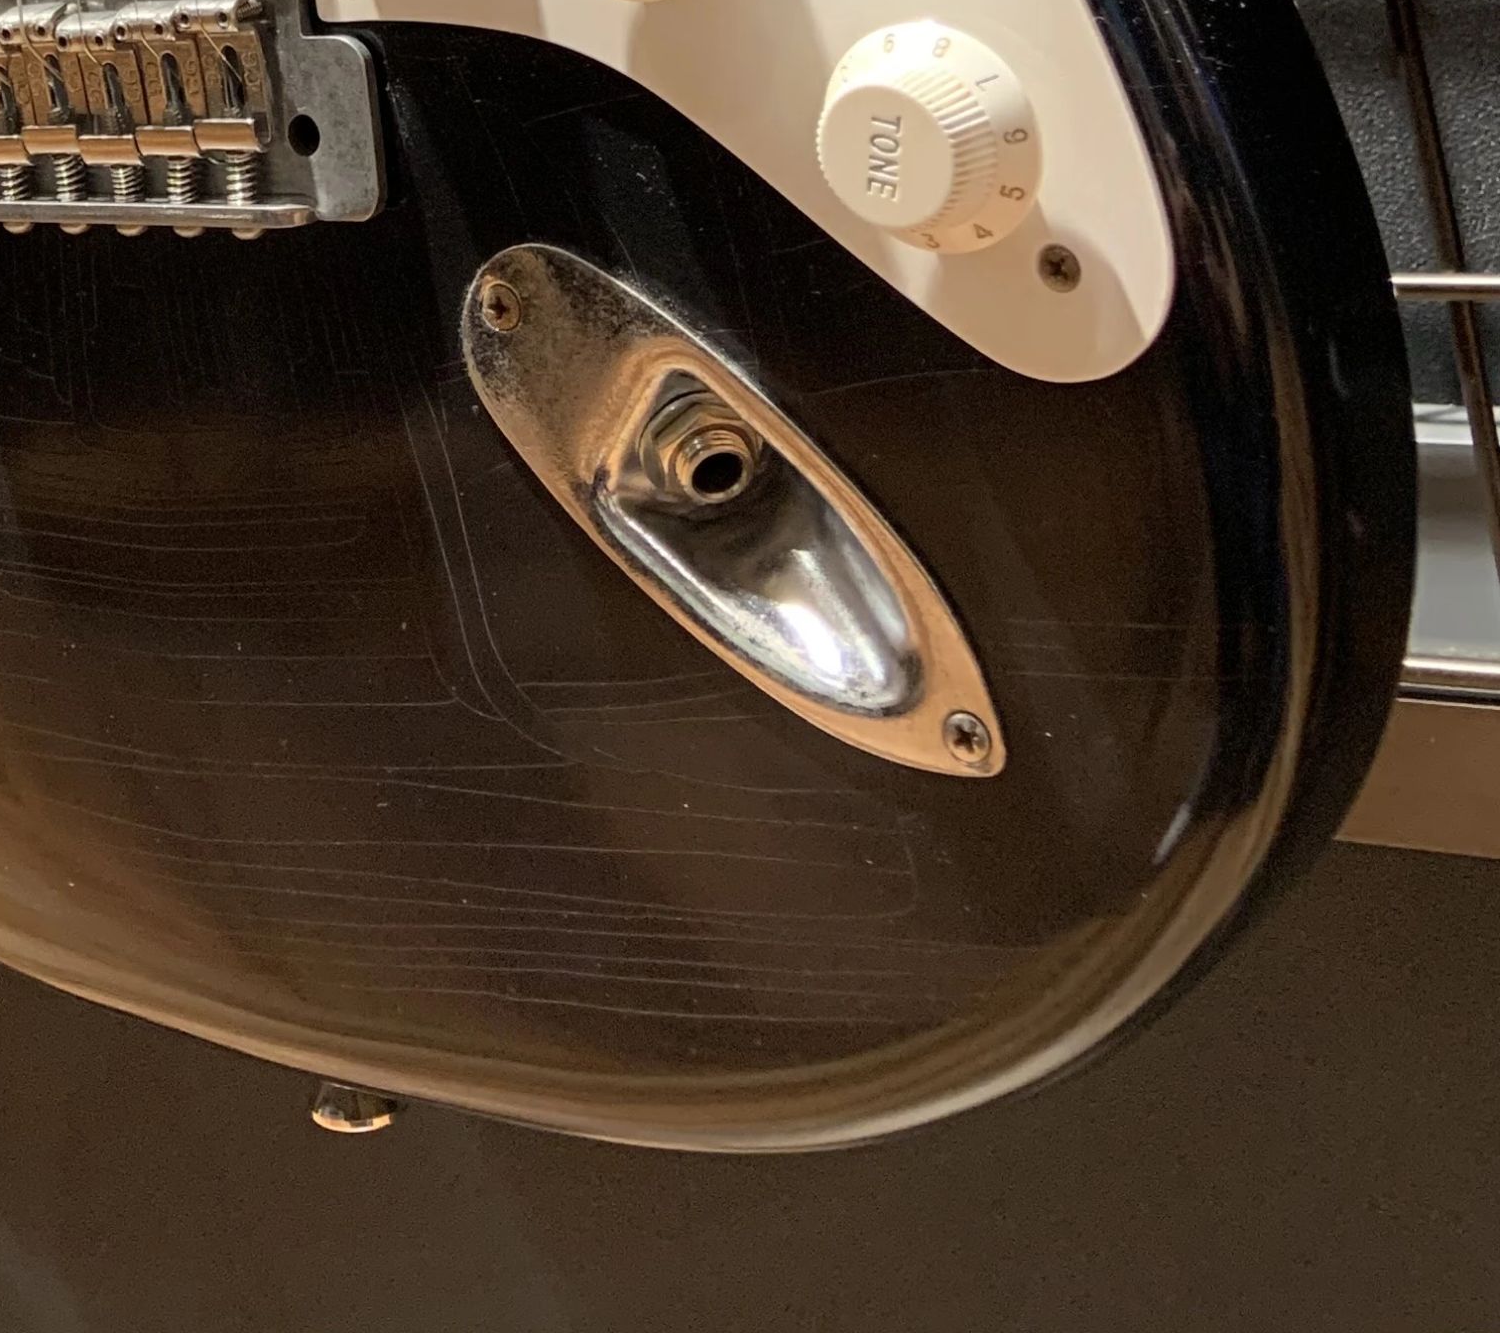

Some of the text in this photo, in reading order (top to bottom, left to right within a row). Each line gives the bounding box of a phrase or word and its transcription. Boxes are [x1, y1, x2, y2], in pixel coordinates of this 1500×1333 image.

[931, 37, 951, 58] 8
[974, 74, 1000, 92] 7
[1003, 128, 1028, 145] 6
[866, 114, 902, 202] TONE
[1000, 184, 1026, 201] 5
[973, 222, 994, 240] 4
[920, 232, 940, 249] 3
